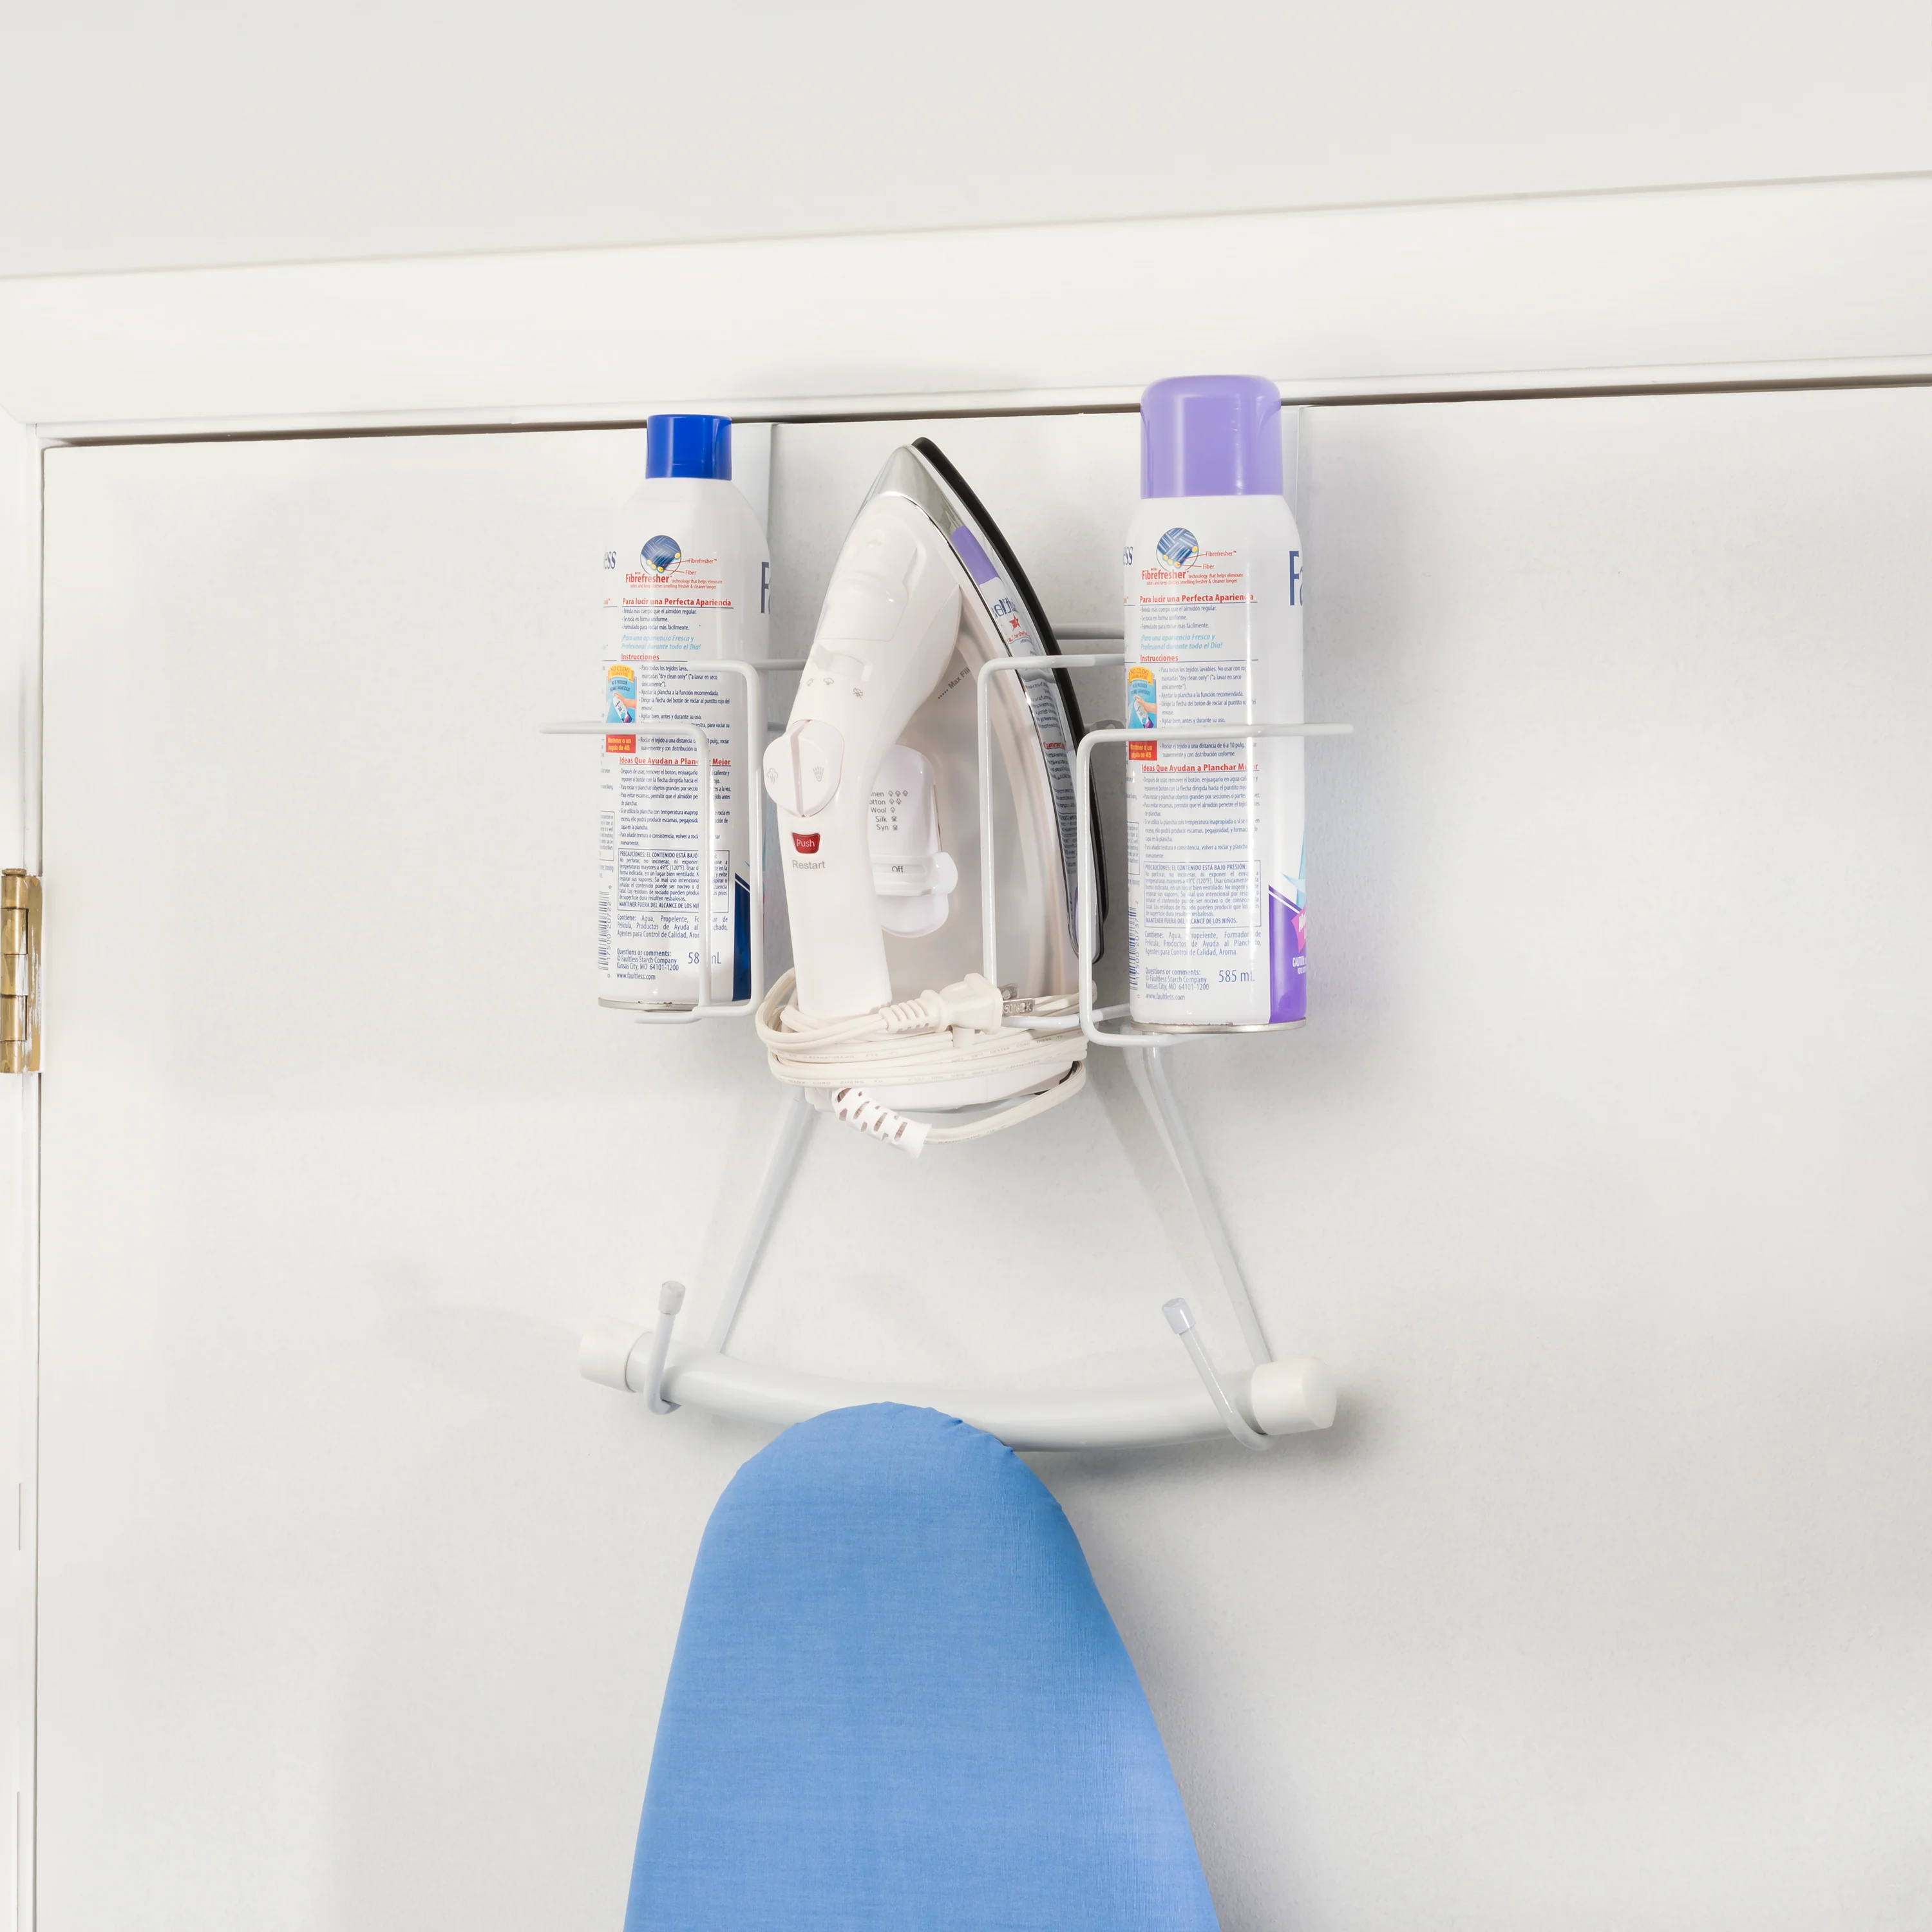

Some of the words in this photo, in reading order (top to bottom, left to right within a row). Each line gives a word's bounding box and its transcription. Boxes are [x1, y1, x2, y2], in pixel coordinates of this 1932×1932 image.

[696, 599, 731, 607] Apariencia
[948, 676, 961, 689] Max
[960, 667, 971, 677] Fill
[796, 839, 815, 848] Push
[792, 860, 826, 869] Restart
[1218, 970, 1236, 982] 585
